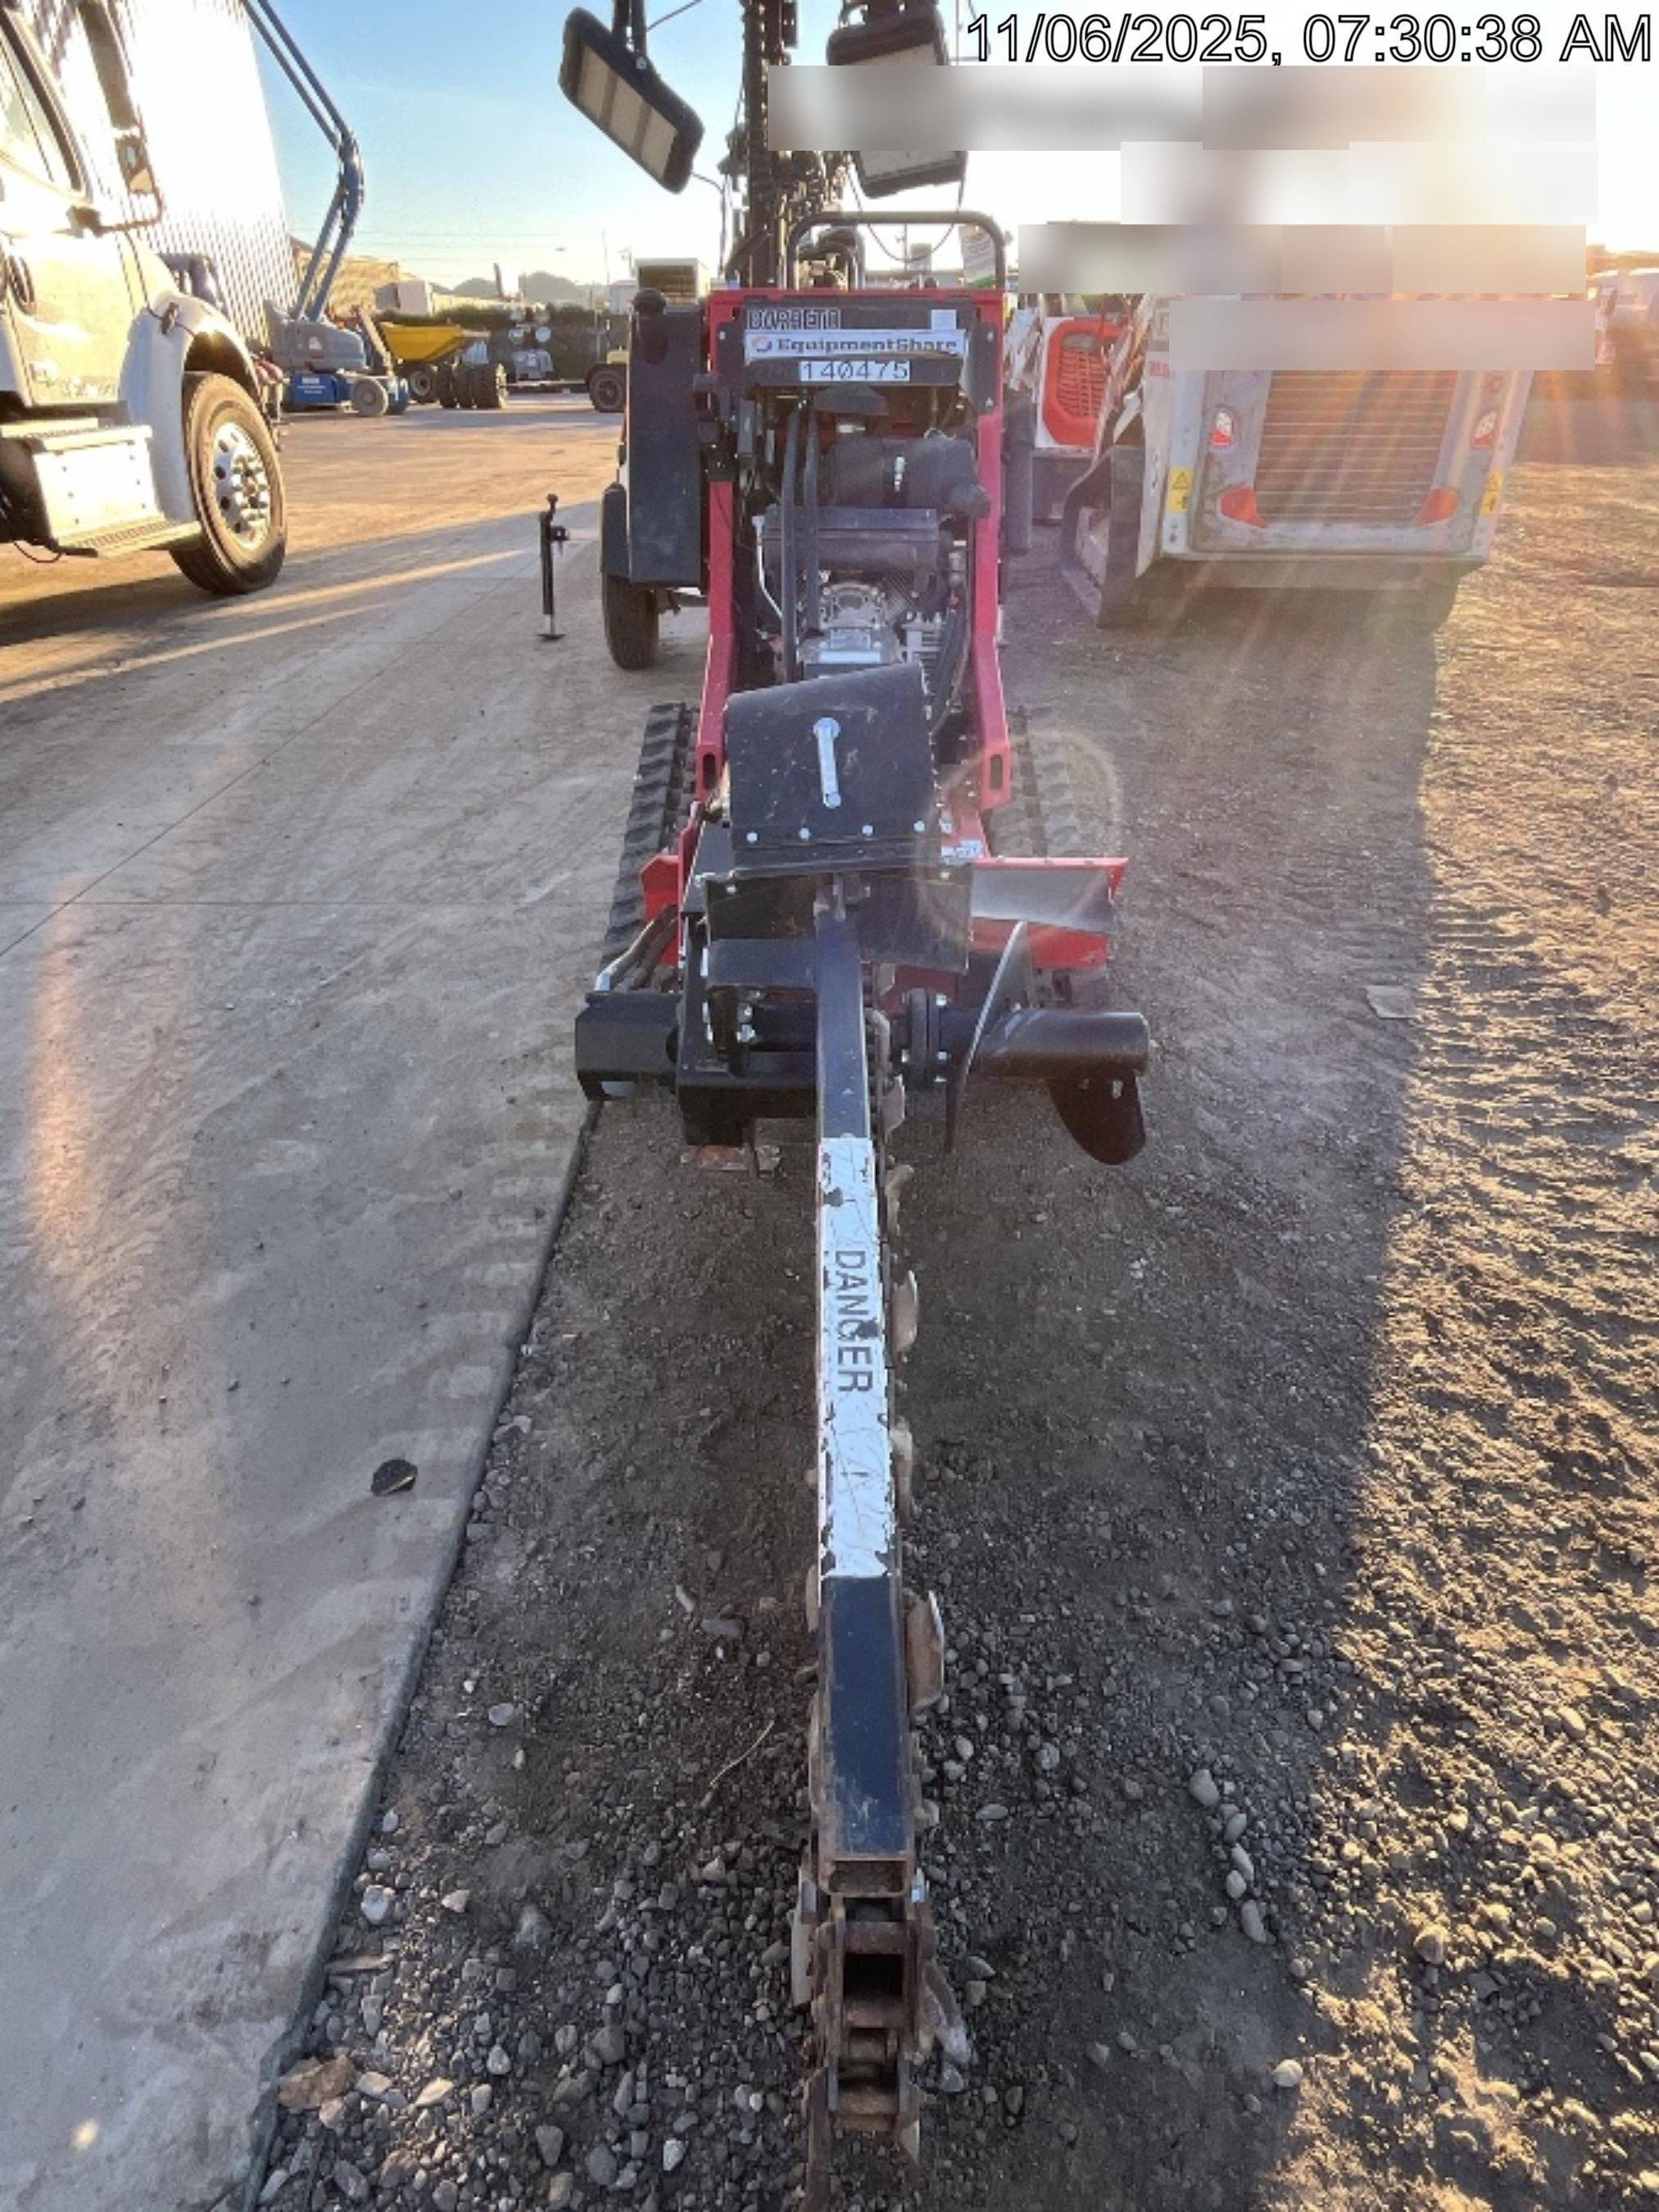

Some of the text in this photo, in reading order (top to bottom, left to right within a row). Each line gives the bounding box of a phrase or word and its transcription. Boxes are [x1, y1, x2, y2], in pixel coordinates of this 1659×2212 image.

[777, 338, 958, 353] EquipmentShare
[803, 360, 909, 380] 140475
[835, 1250, 873, 1392] DANGER
